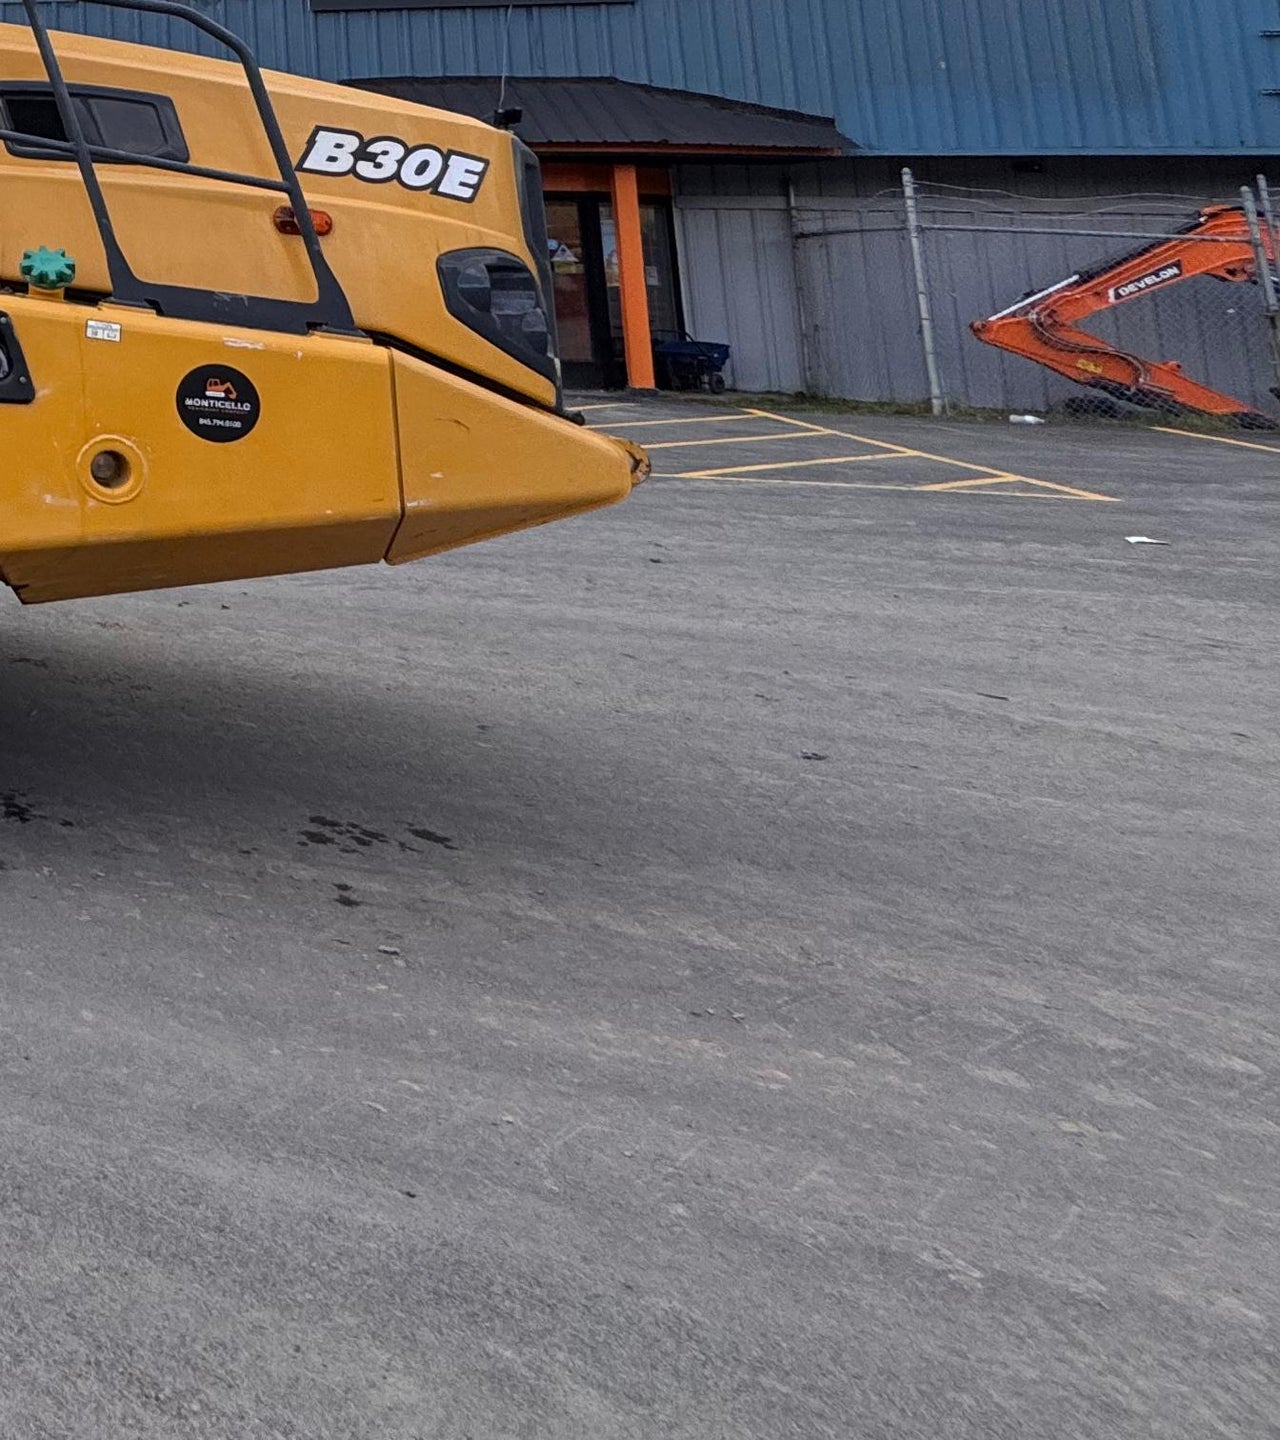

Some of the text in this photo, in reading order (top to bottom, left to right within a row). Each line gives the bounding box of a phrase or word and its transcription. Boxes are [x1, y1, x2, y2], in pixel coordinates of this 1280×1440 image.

[298, 127, 488, 201] B30E
[1117, 265, 1181, 296] DEVELON
[184, 397, 252, 411] MONTICELLO
